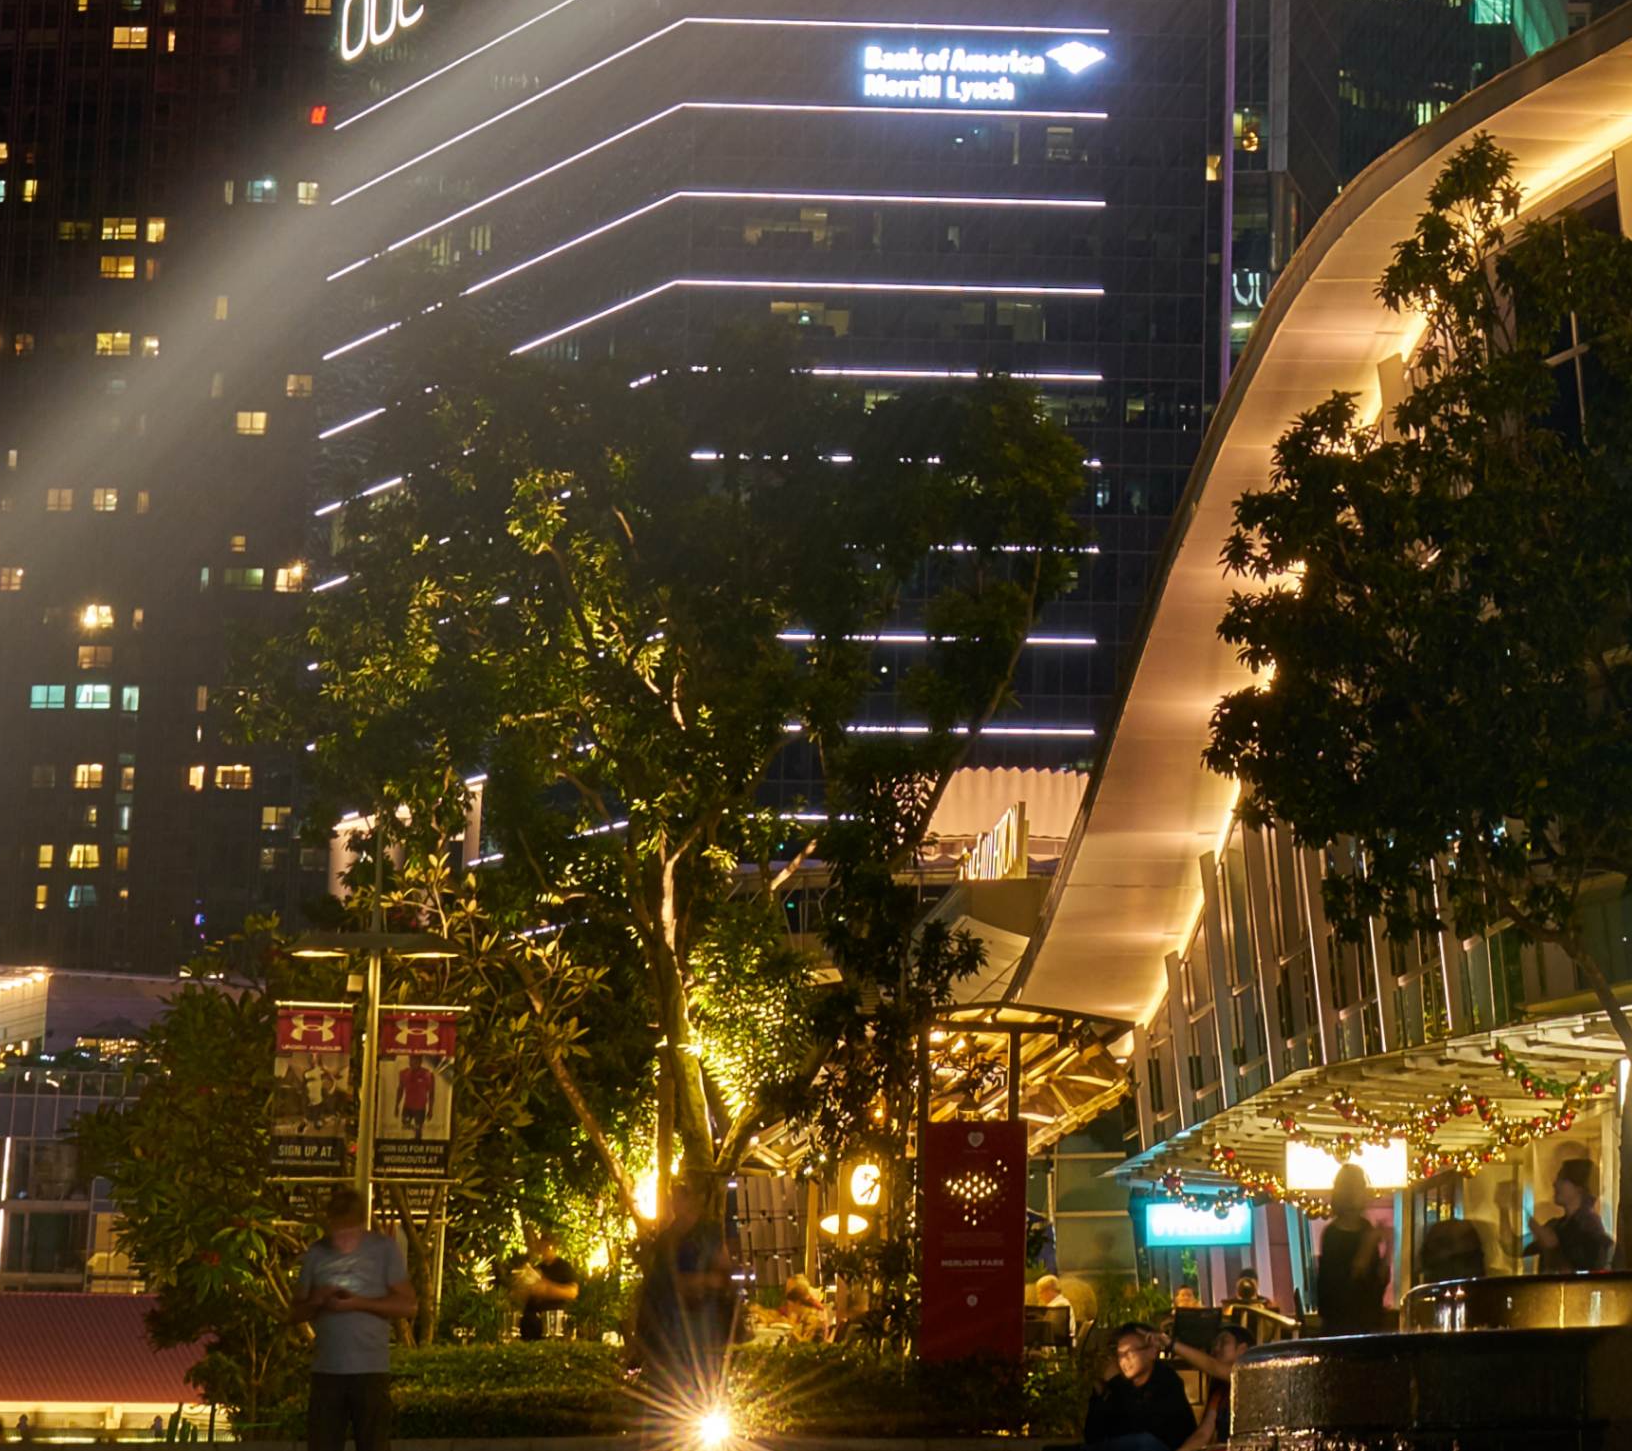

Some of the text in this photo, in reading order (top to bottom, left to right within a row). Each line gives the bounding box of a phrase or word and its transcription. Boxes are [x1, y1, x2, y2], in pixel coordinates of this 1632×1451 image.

[864, 46, 1045, 74] Bank of America
[864, 74, 1015, 103] Merrill Lynch
[278, 1145, 333, 1158] SIGN UP AT
